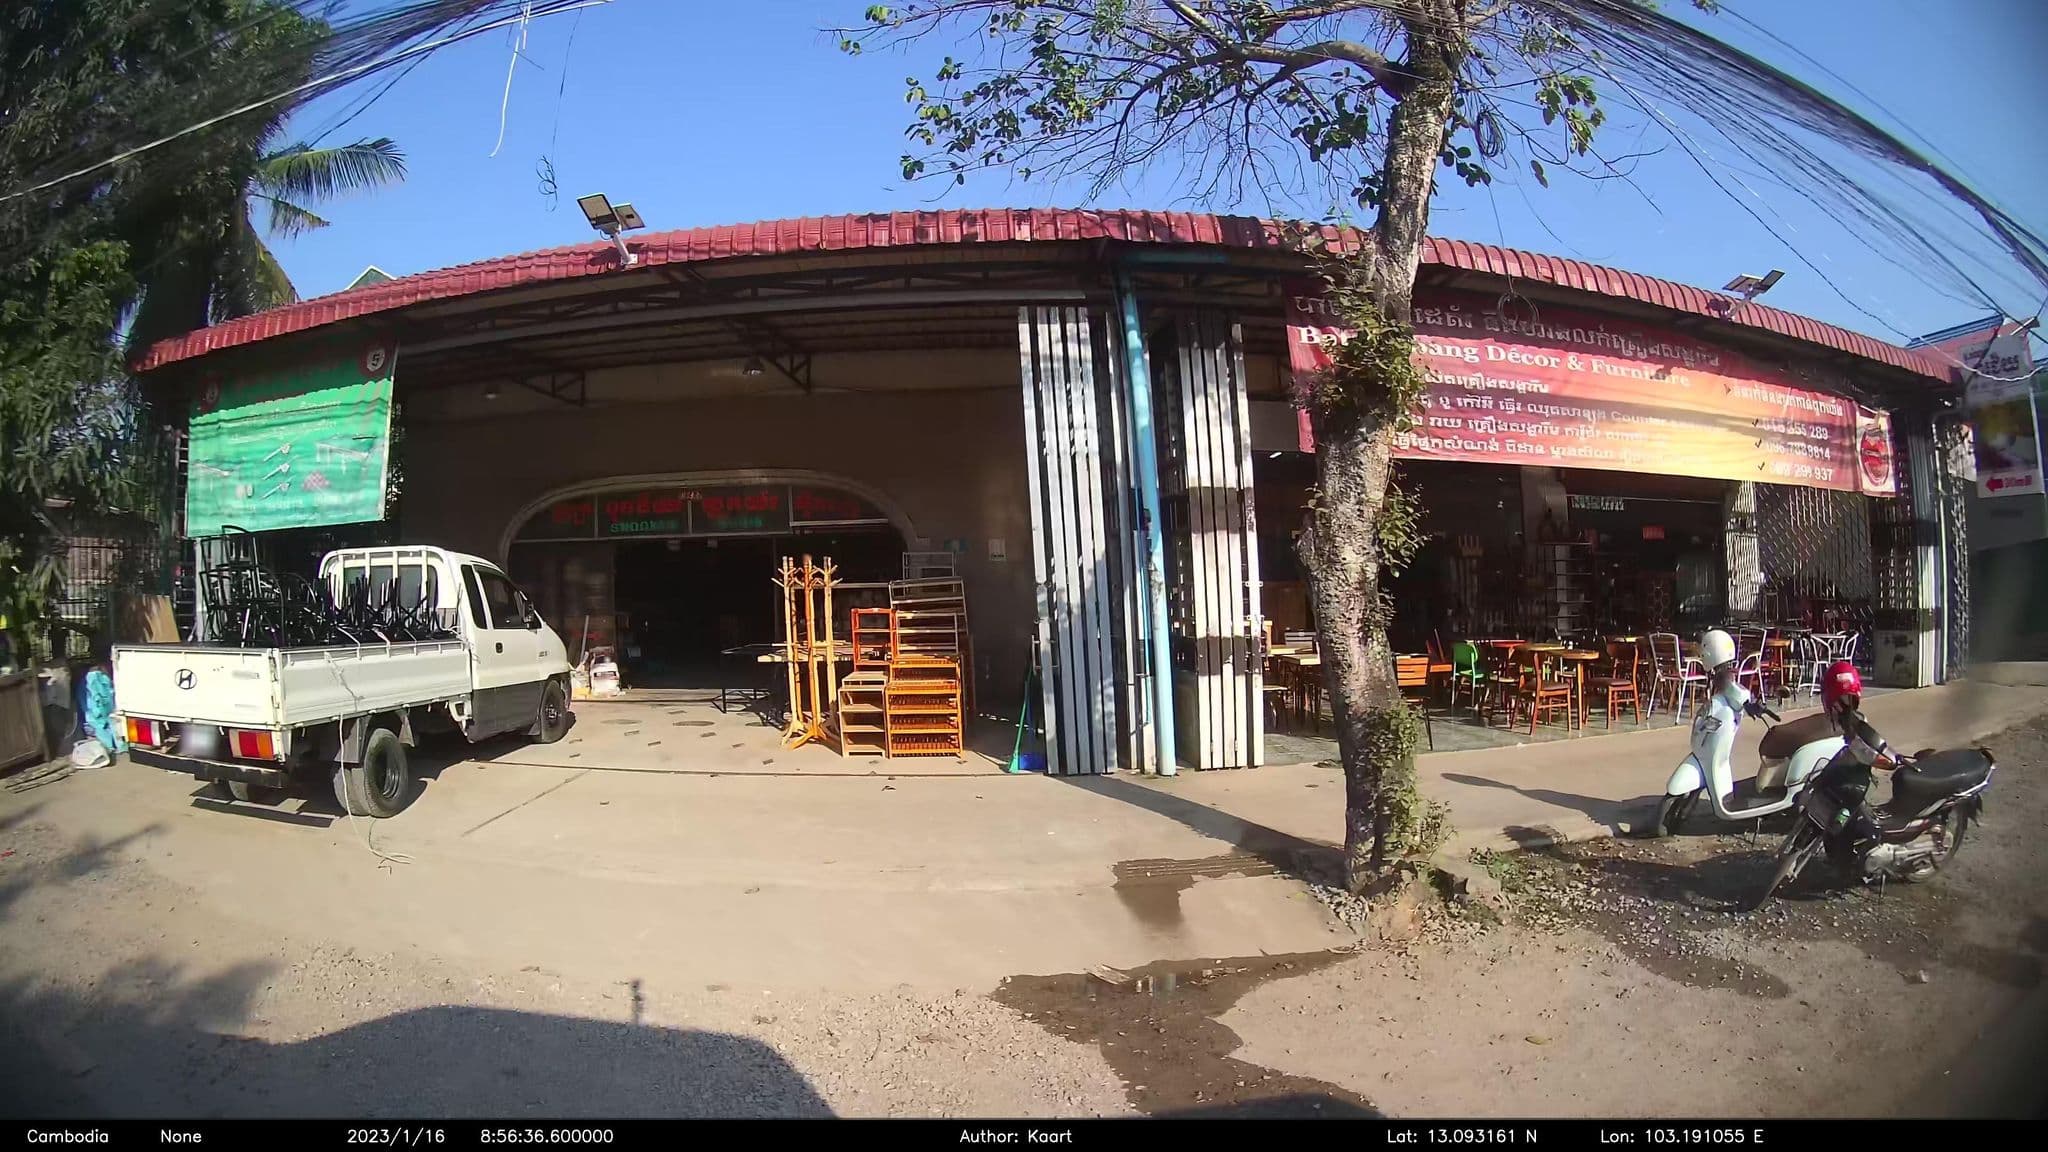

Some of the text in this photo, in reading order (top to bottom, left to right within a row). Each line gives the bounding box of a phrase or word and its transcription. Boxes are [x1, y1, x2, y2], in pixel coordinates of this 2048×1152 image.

[1486, 343, 1561, 369] Décor
[1567, 354, 1584, 372] &
[1810, 426, 1829, 440] 289
[1815, 467, 1833, 482] 937
